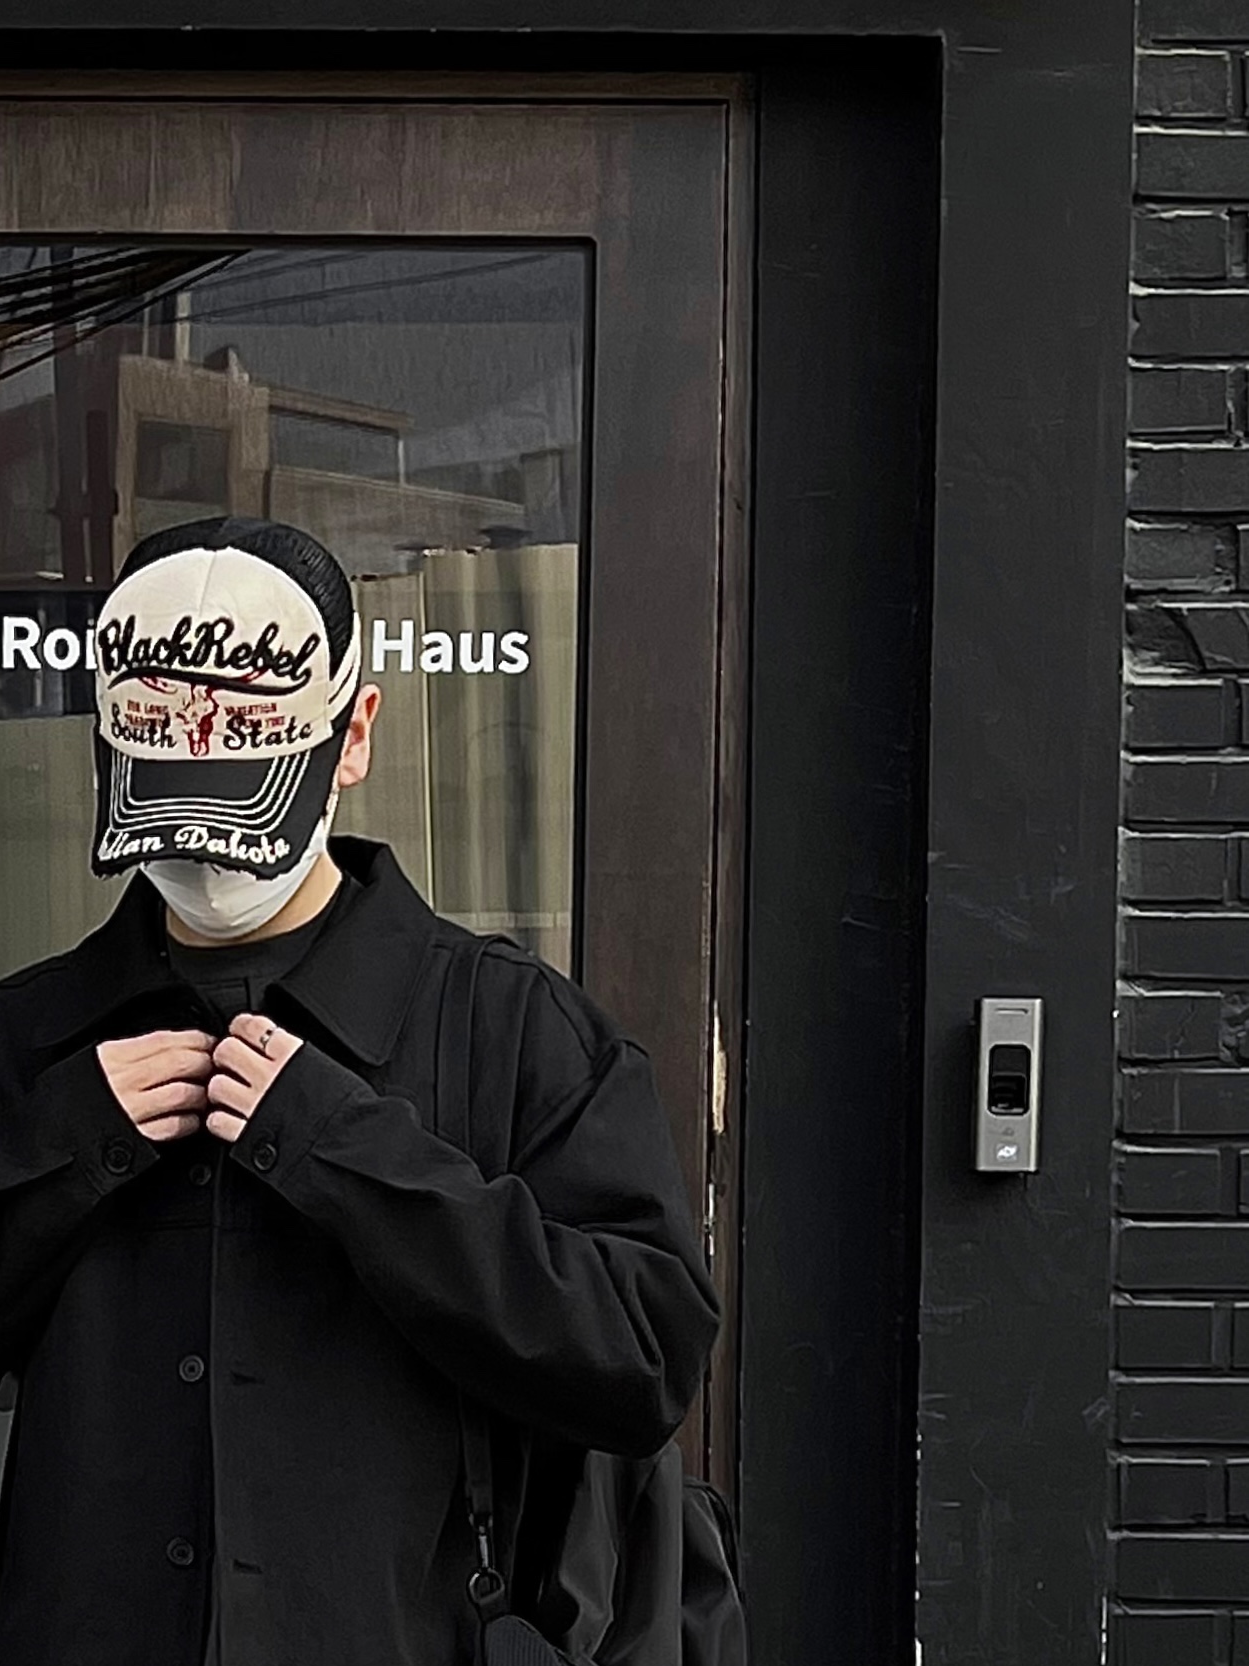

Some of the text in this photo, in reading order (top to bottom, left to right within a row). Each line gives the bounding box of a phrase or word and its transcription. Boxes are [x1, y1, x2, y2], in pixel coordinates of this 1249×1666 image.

[372, 619, 530, 674] Haus
[111, 702, 313, 751] South State
